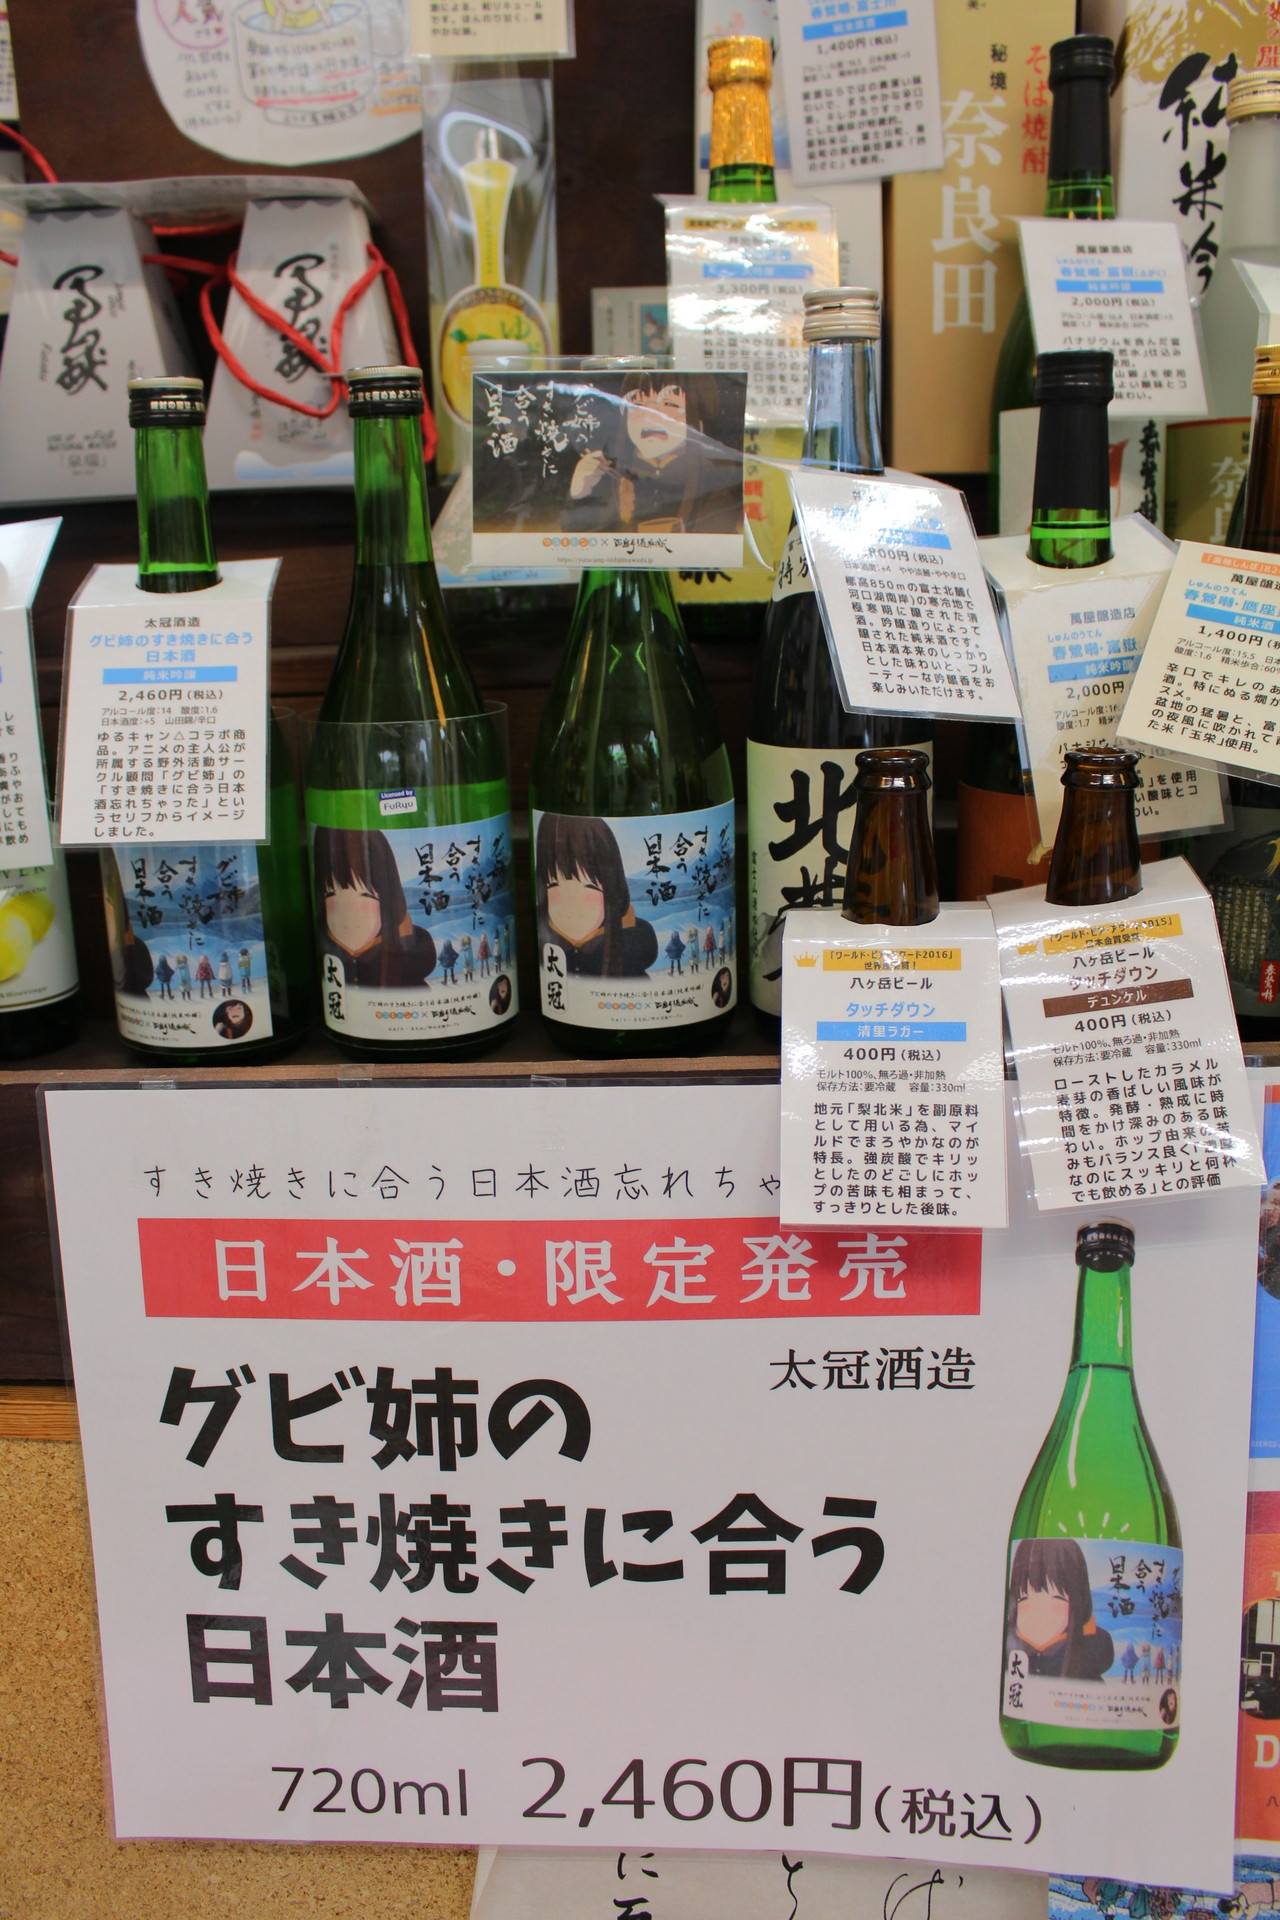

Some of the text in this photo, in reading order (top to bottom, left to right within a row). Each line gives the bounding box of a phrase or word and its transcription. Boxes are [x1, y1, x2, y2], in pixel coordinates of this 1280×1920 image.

[990, 43, 1008, 91] 秘境
[1021, 44, 1049, 175] そば焼酎
[931, 89, 1010, 335] 奈良田
[1071, 297, 1156, 307] 2,000円(税込)
[144, 616, 201, 628] 太冠酒造
[855, 614, 981, 636] 酒。吟醸造りによって
[1233, 614, 1276, 631] 純米酒
[88, 631, 253, 648] グビ姉のすき焼きに合う
[858, 627, 981, 648] 醸された純米酒です。
[146, 650, 197, 662] 日本酒
[862, 641, 988, 661] 日本酒本来のしっかり
[866, 655, 992, 674] とした味わいと、フル
[118, 688, 225, 701] 2,460円(税込)
[872, 682, 983, 700] 楽しみいただけます。
[1066, 681, 1125, 700] 2,000円
[1159, 685, 1192, 700] スメ。
[101, 705, 218, 716] アルコール度:14 酸度:1.6
[101, 716, 155, 727] 日本酒度:+5
[97, 728, 246, 743] ゆるキャン△コラボ商
[1147, 718, 1260, 754] た米「玉栄」使用。
[96, 742, 246, 756] 品。アニメの主人公が
[95, 755, 246, 770] 所属する野外活動サー
[95, 769, 246, 783] クル顧問「グビ姉」の
[99, 783, 246, 796] 「すき焼きに合う日本
[381, 790, 405, 799] Licensed
[94, 797, 246, 810] 酒忘れちゃった」とい
[94, 810, 246, 824] うセリフからイメージ
[94, 825, 155, 838] しました。
[670, 832, 694, 874] 合う
[414, 842, 451, 916] 日本酒
[643, 833, 677, 907] 日本酒
[1073, 946, 1154, 968] 八ヶ岳ビール
[546, 946, 566, 1011] 太冠
[849, 976, 934, 990] 八ヶ岳ビール
[326, 957, 345, 1022] 太冠
[1087, 989, 1147, 1008] デュンケル
[845, 1001, 936, 1017] タッチダウン
[1074, 1009, 1172, 1033] 400円(税込)
[857, 1025, 925, 1038] 清里ラガー
[843, 1047, 942, 1062] 400円(税込)
[1053, 1037, 1202, 1067] 保存方法:要冷蔵 容量:330ml
[816, 1069, 947, 1081] モルト100%、無ろ過・非加熱
[1054, 1057, 1219, 1090] ローストしたカラメル
[816, 1081, 966, 1093] 保存方法:要冷蔵 容量:330ml
[1056, 1073, 1222, 1106] 麦芽の香ばしい風味が
[813, 1102, 979, 1117] 地元「梨北米」を副原料
[1058, 1089, 1224, 1122] 特徴。発酵・熟成に時
[814, 1119, 979, 1133] として用いる為、マイ
[1061, 1105, 1228, 1139] 間をかけ深みのある味
[813, 1135, 980, 1149] ルドでまろやかなのが
[812, 1151, 979, 1166] 特長。強炭酸でキリッ
[814, 1167, 979, 1182] としたのどごしにホッ
[1069, 1153, 1237, 1187] なのにスッキリと何杯
[813, 1184, 974, 1200] プの苦味も相まって、
[1072, 1173, 1221, 1203] でも飲める」との評価
[812, 1201, 959, 1217] すっきりとした後味。
[213, 1234, 909, 1309] 日本酒・限定発売
[769, 1346, 977, 1392] 太冠酒造
[158, 1363, 593, 1472] グビ姉の
[165, 1492, 886, 1596] すき焼きに合う
[185, 1612, 501, 1713] 日本酒
[1009, 1653, 1025, 1709] 太冠
[271, 1757, 1042, 1845] 720ml 2,460円(税込)
